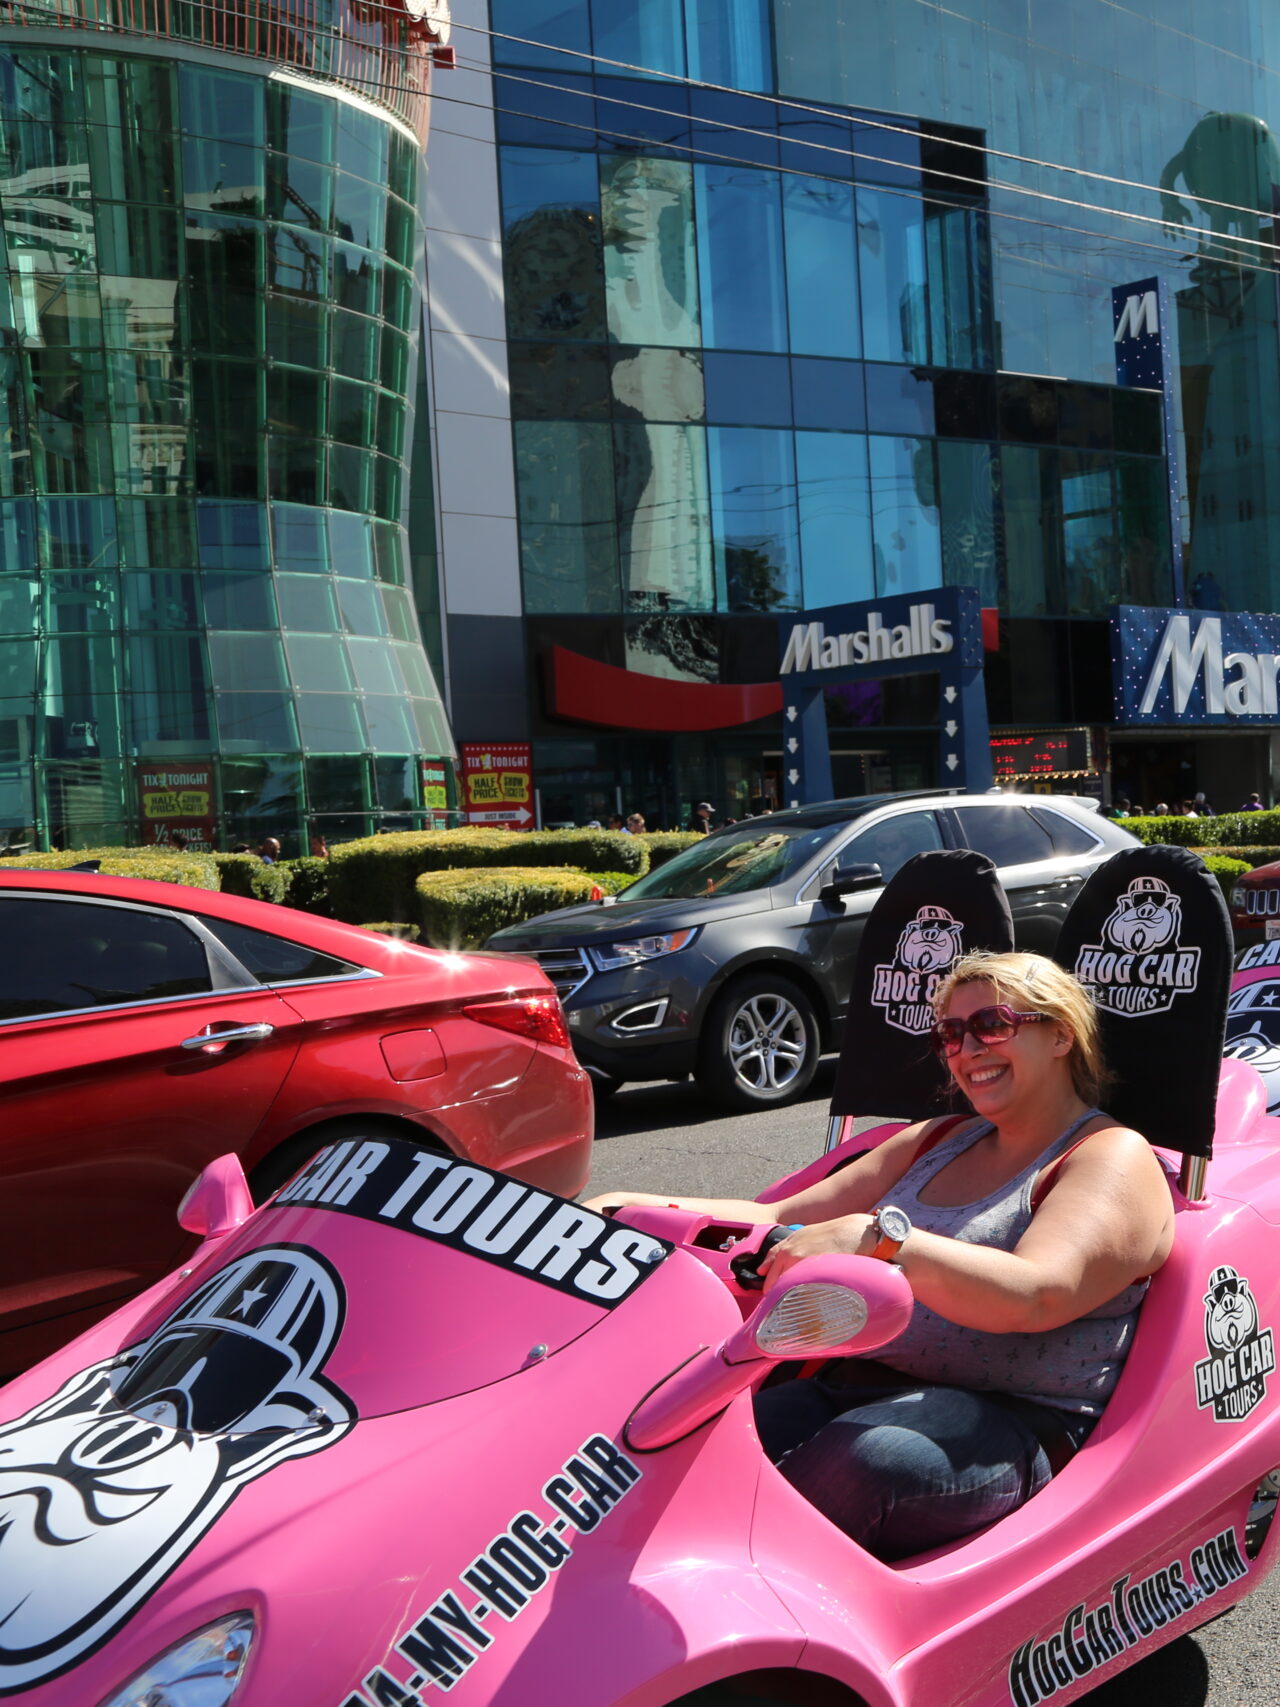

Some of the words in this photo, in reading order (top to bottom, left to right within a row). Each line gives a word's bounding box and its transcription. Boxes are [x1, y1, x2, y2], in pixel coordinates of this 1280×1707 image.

[1113, 290, 1160, 343] M
[779, 603, 954, 675] Marshalls
[466, 757, 480, 768] TIX
[492, 756, 529, 768] TONIGHT
[142, 774, 159, 786] TIX
[167, 773, 209, 786] TONIGHT
[473, 778, 495, 788] HALF
[473, 788, 499, 799] PRICE
[875, 970, 922, 1002] HOG
[1079, 952, 1136, 985] HOG
[1138, 953, 1197, 988] CAR
[1105, 987, 1160, 1013] TOURS
[274, 1141, 391, 1207] CAR
[378, 1151, 656, 1293] TOURS
[1199, 1355, 1239, 1401] HOG
[1239, 1342, 1274, 1383] CAR
[1222, 1382, 1258, 1418] TOURS
